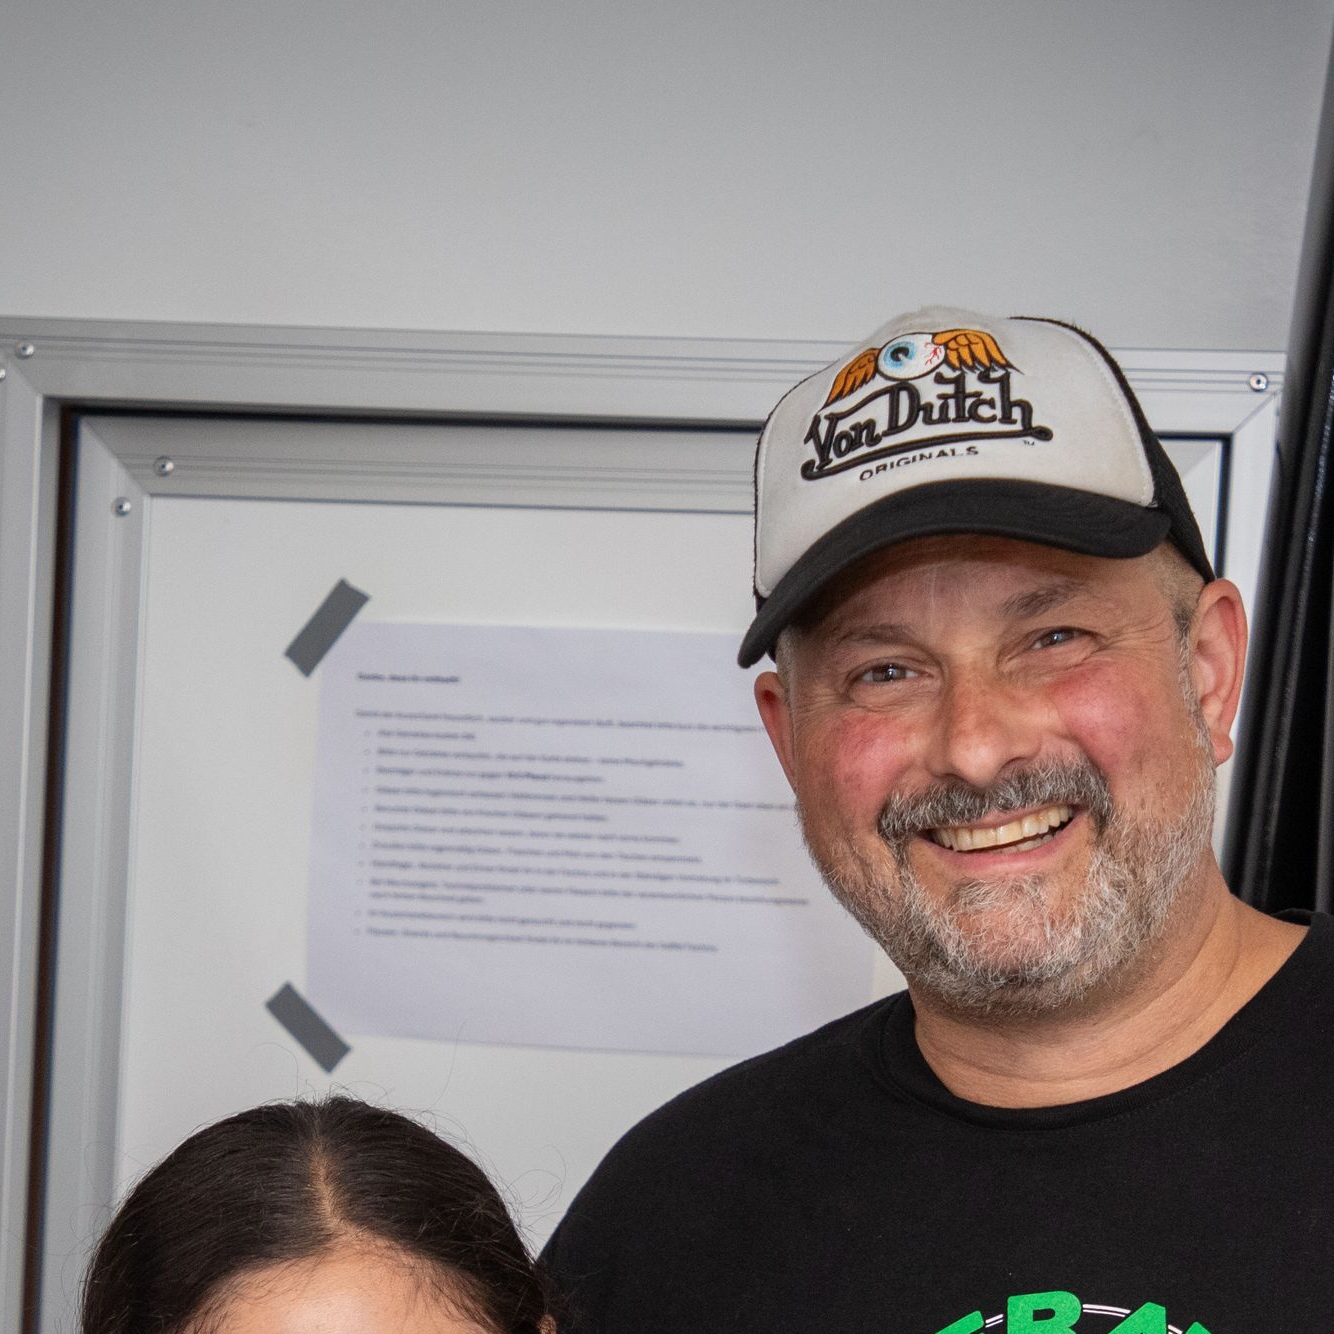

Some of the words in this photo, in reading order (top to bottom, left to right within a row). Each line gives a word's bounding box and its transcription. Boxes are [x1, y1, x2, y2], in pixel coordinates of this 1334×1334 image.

[804, 411, 883, 467] Von
[881, 371, 1035, 437] Dutch
[859, 446, 979, 481] ORIGINALS
